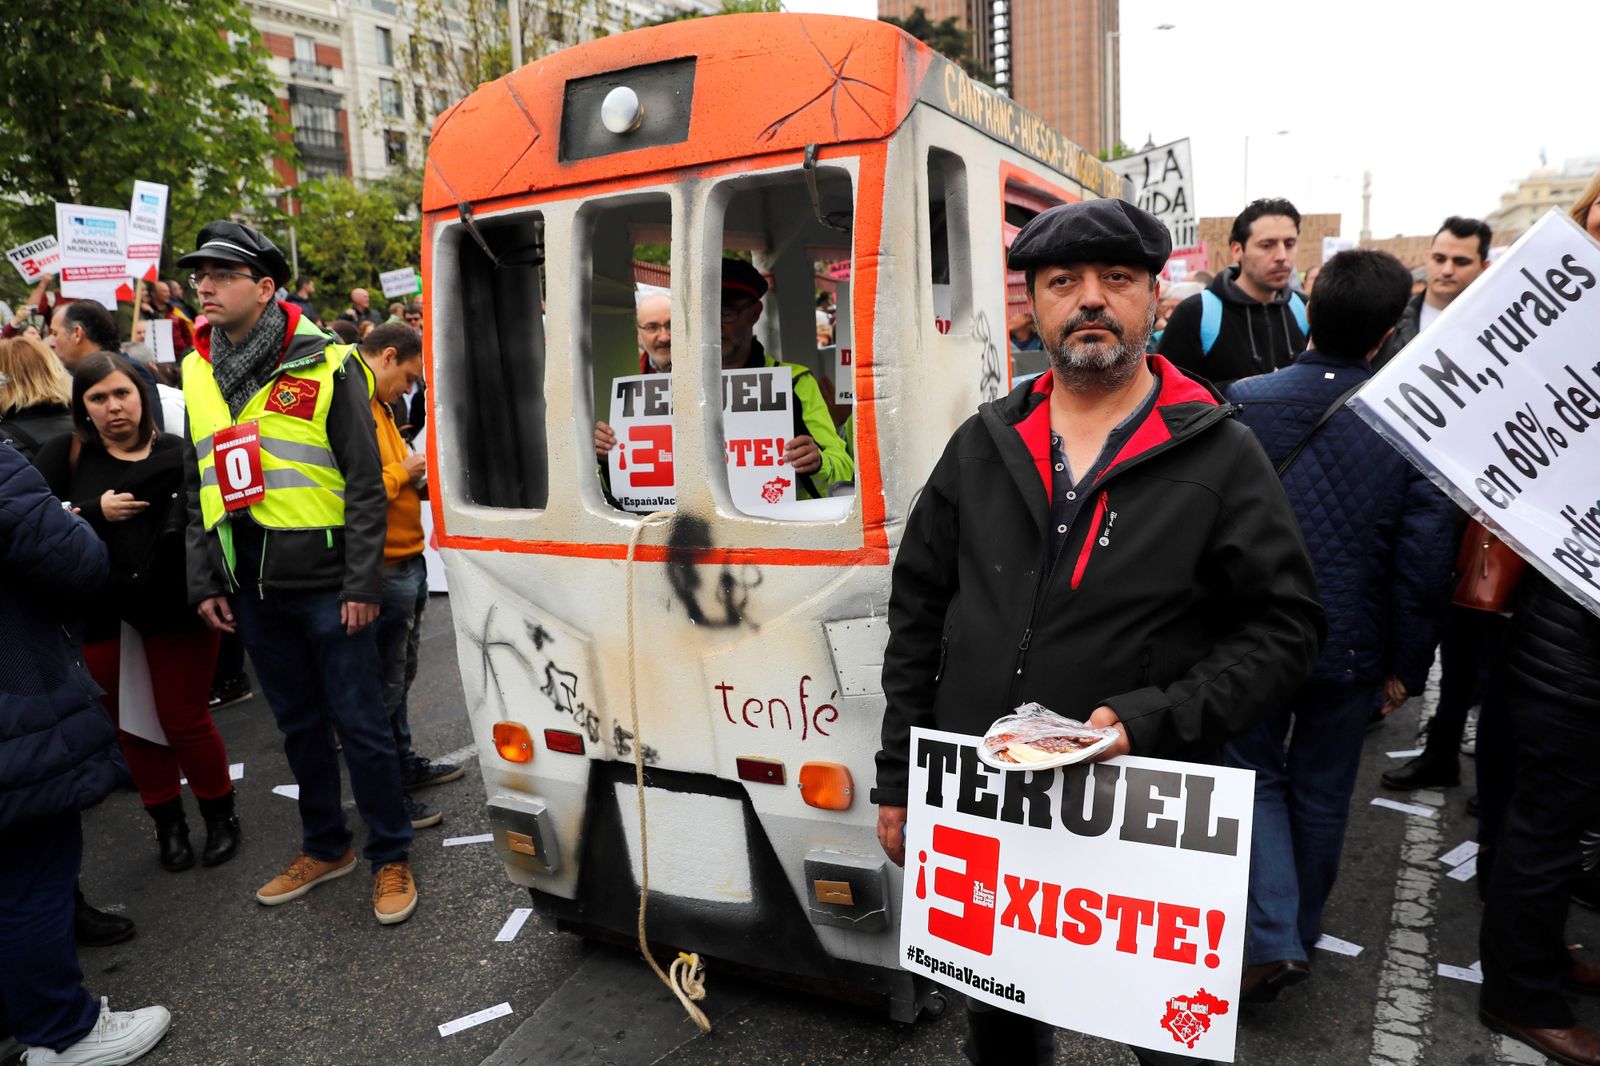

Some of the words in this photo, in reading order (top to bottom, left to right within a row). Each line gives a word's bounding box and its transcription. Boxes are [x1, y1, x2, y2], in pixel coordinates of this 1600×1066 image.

[1143, 149, 1183, 188] LA
[10, 239, 57, 261] TERUEL
[1477, 252, 1597, 367] rurales
[1545, 364, 1600, 434] del
[1492, 401, 1569, 481] 60%
[1474, 463, 1523, 510] en
[916, 737, 1240, 857] TERUEL
[906, 944, 1026, 1005] #EspañaVaciada
